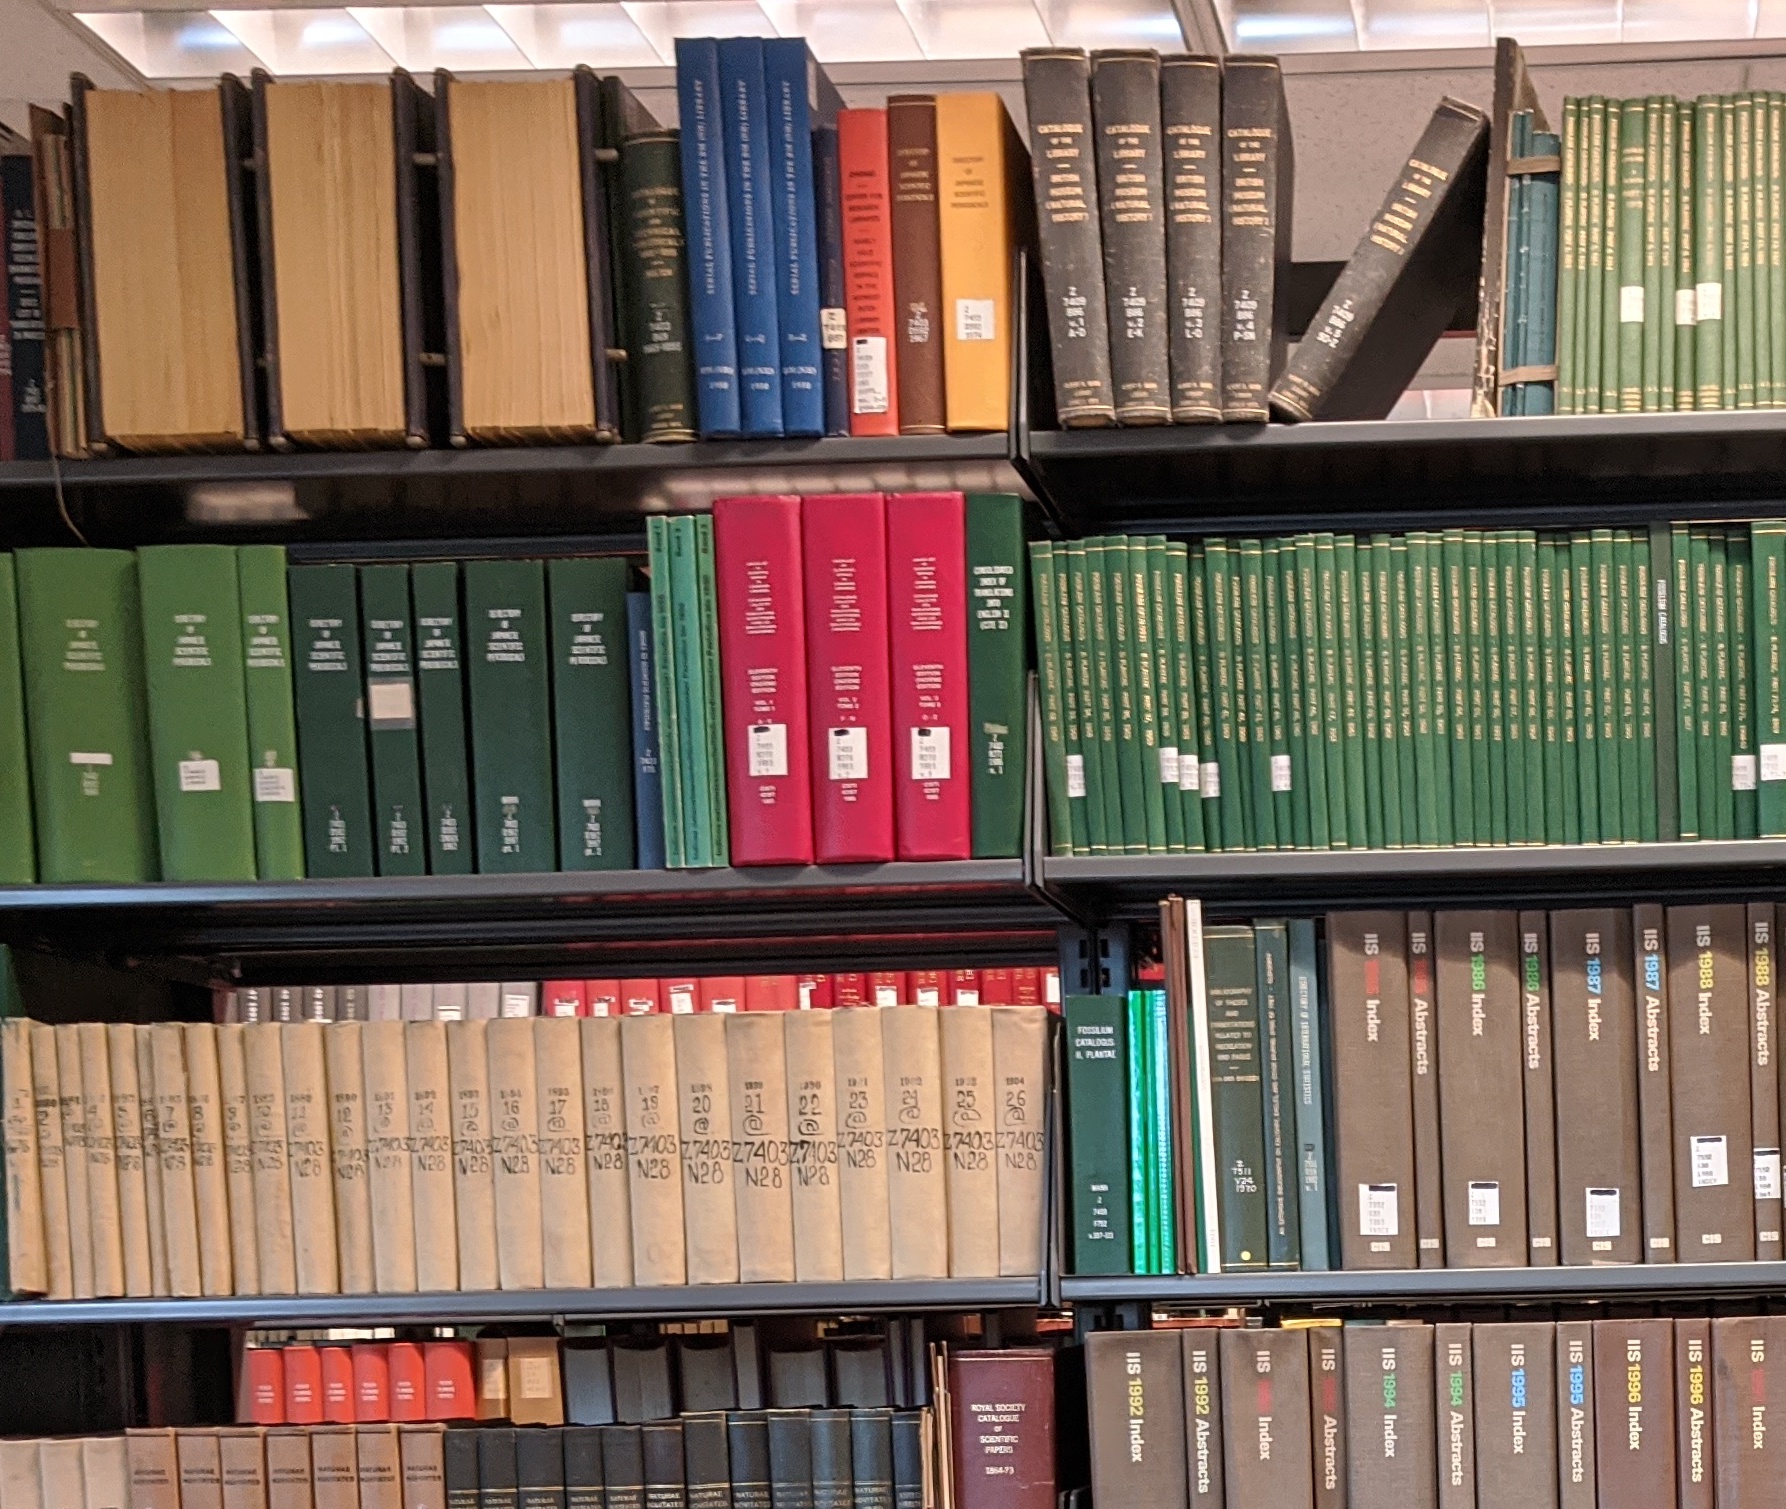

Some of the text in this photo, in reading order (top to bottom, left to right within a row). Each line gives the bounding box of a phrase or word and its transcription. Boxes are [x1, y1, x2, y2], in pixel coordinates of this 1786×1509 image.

[1470, 931, 1485, 1037] IIS 1986 Index
[1585, 932, 1601, 1043] IIS 1987 Index
[1696, 925, 1714, 1036] IIS 1988 Index
[745, 1094, 762, 1114] 21
[1006, 1089, 1025, 1107] 26
[888, 1128, 940, 1151] Z7403
[732, 1140, 789, 1164] Z7403
[897, 1151, 932, 1173] N28
[1006, 1151, 1037, 1171] N28
[745, 1167, 782, 1189] N28
[1380, 1347, 1397, 1459] IIS 1994 Index
[1509, 1342, 1526, 1455] IIS 1995 Index
[1625, 1338, 1642, 1451] IIS 1996 Index
[972, 1403, 1026, 1412] ROYAL SOCIETY
[977, 1414, 1020, 1422] CATALOGUE
[1124, 1351, 1145, 1463] IIS 1992 Index
